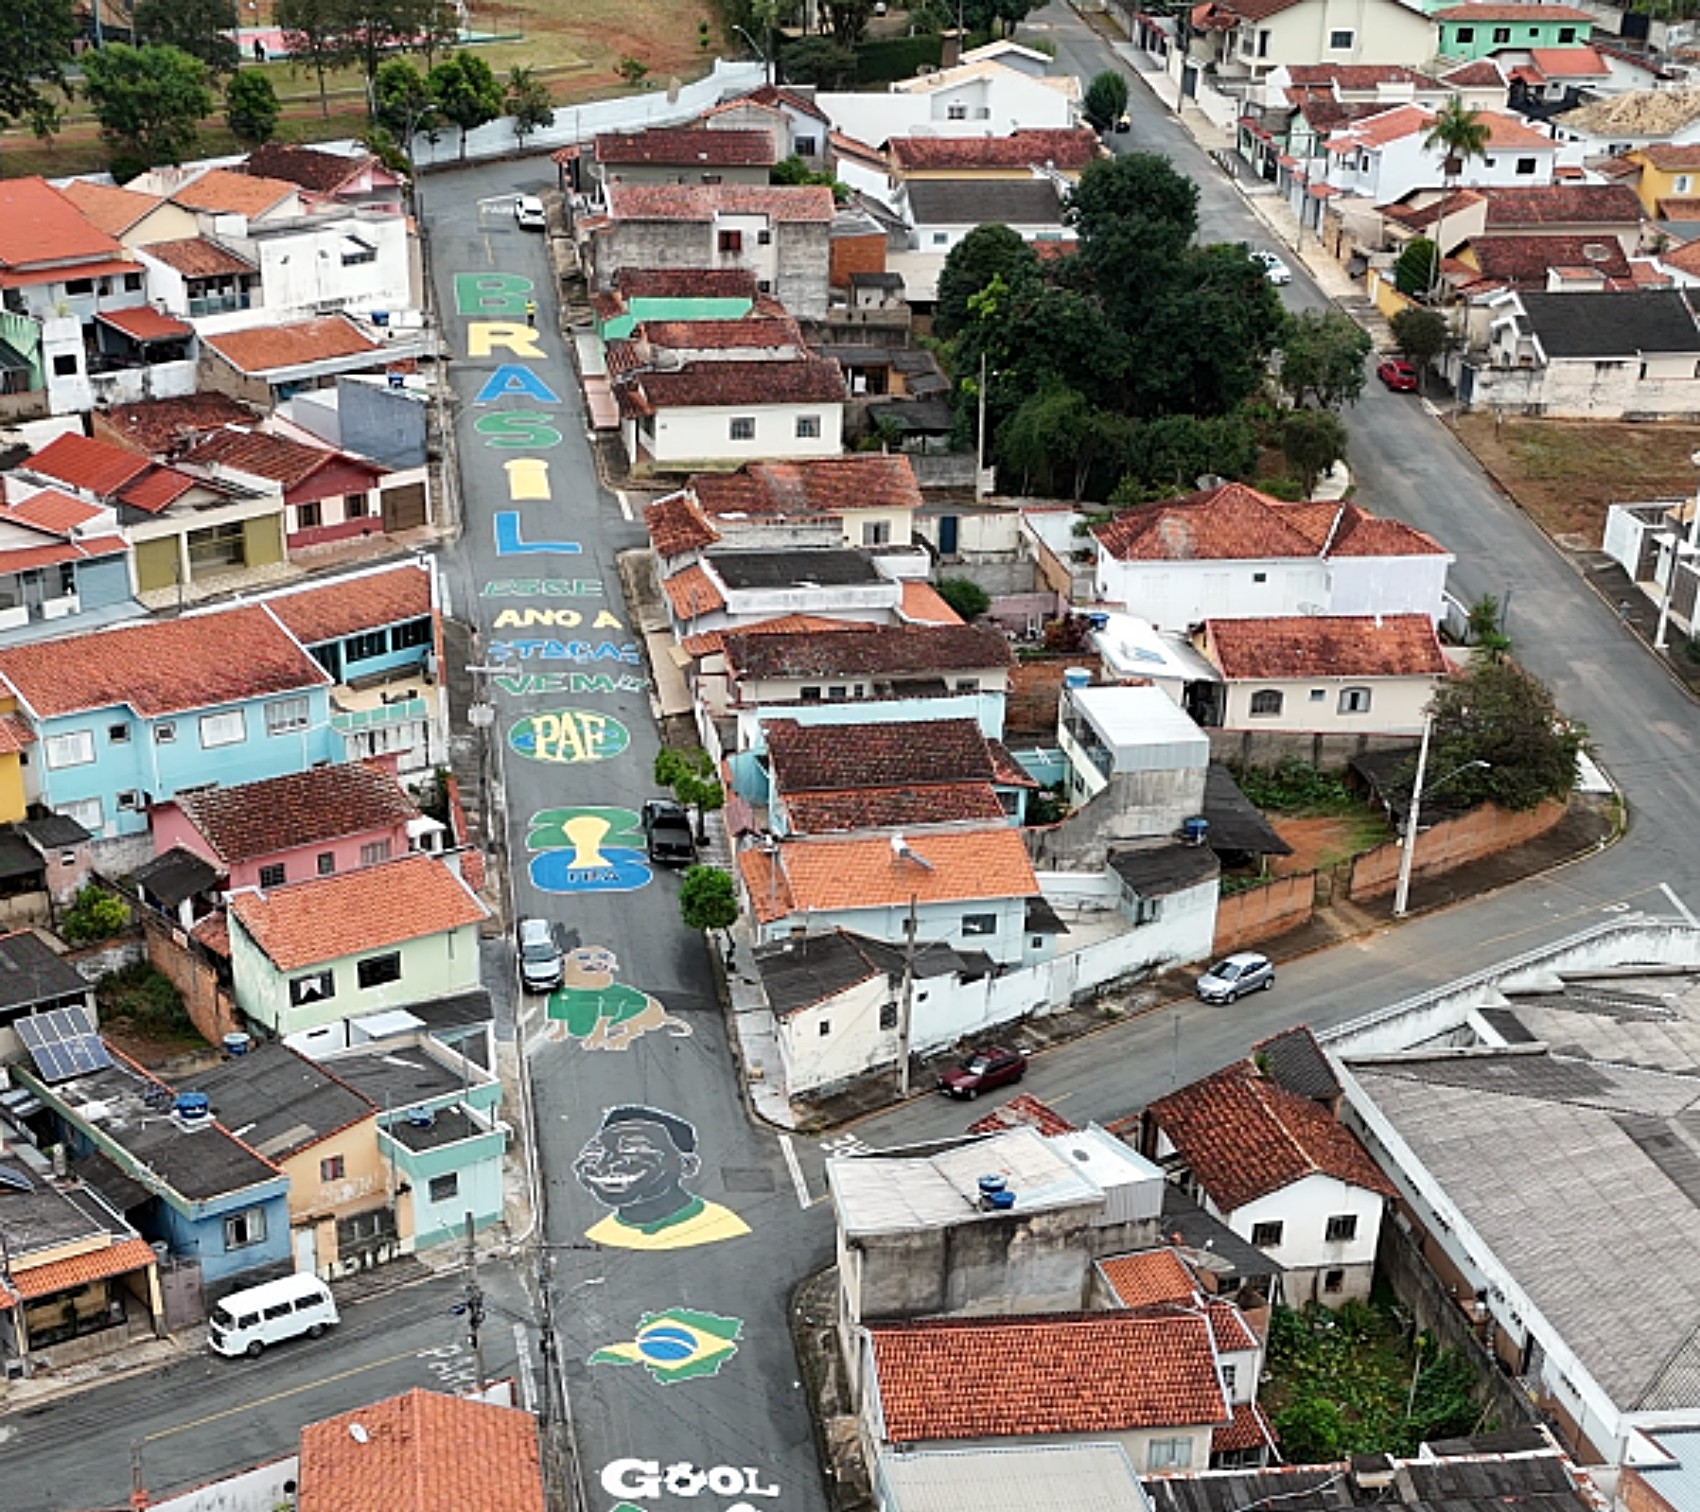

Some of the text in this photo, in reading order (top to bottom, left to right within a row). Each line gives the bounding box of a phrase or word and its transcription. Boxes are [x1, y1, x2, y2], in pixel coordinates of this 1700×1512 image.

[454, 272, 582, 557] BRASIL
[493, 607, 622, 629] ANO A
